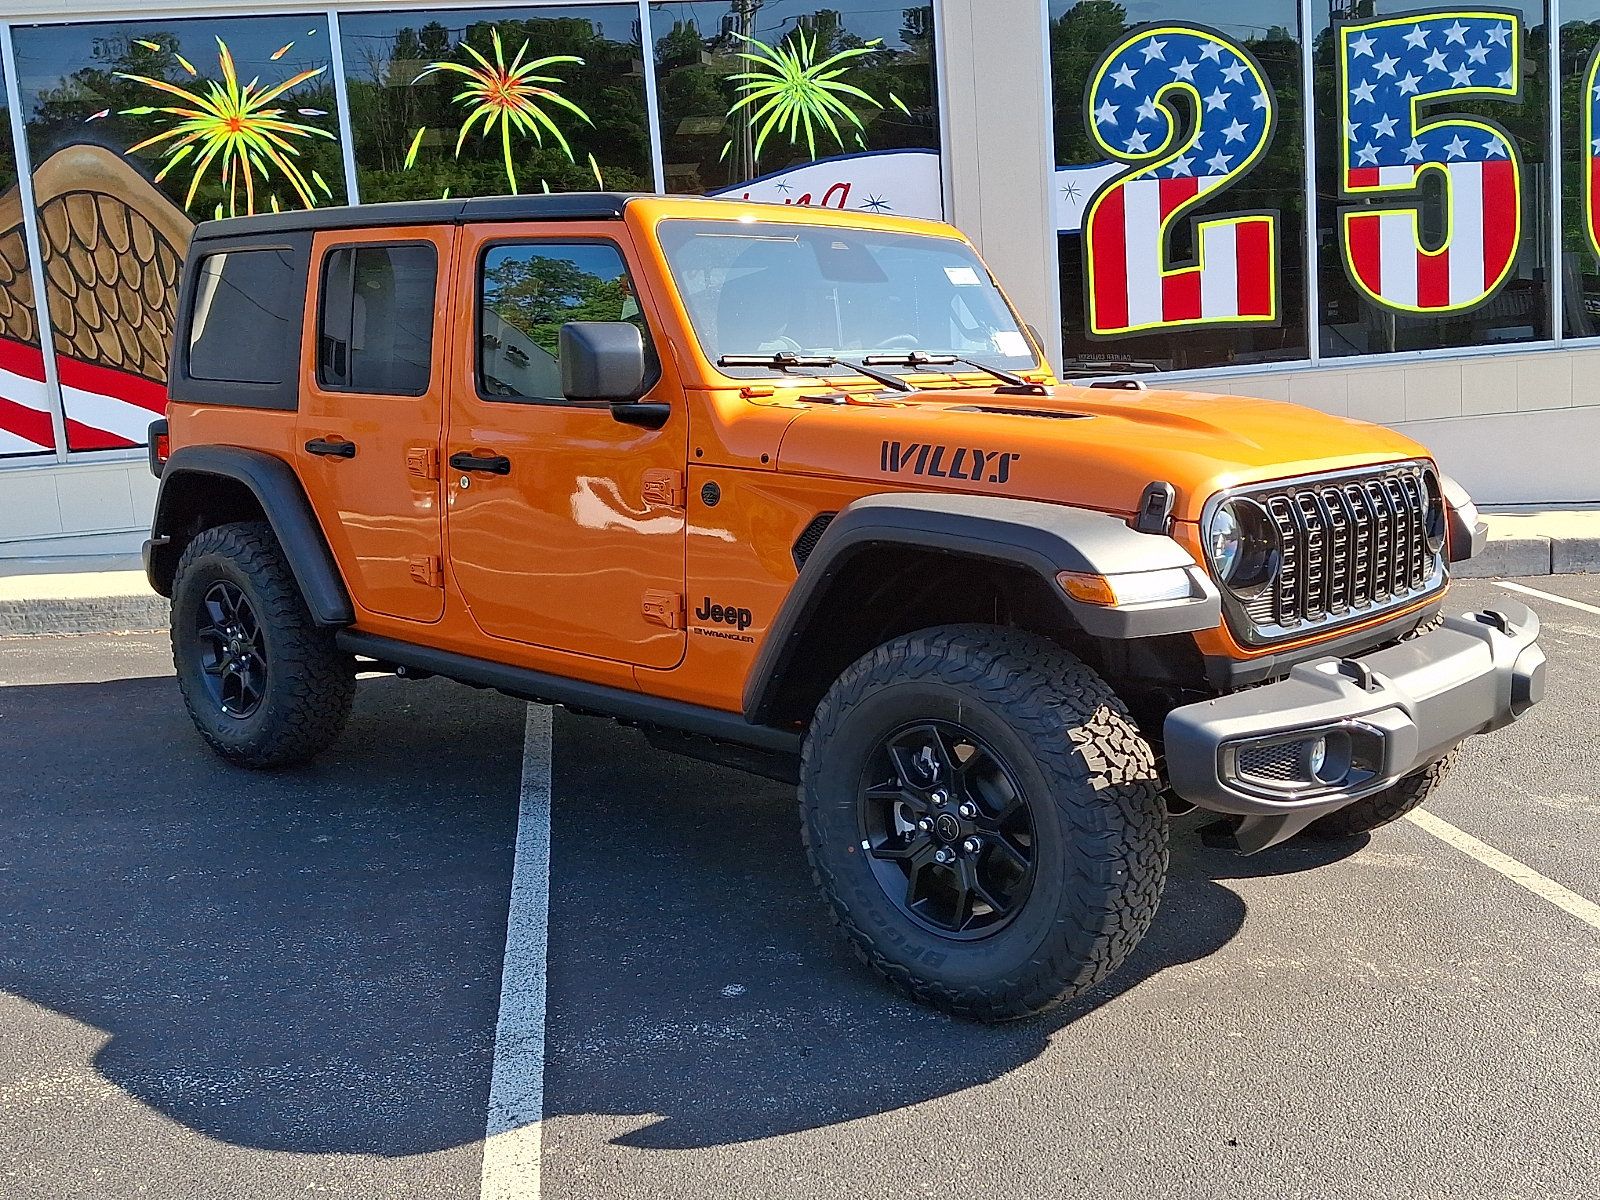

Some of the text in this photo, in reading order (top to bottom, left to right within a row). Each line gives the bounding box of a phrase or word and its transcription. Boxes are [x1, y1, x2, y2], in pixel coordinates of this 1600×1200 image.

[881, 440, 1020, 483] WILLYS
[695, 596, 752, 631] Jeep
[703, 628, 755, 643] WRANGLER
